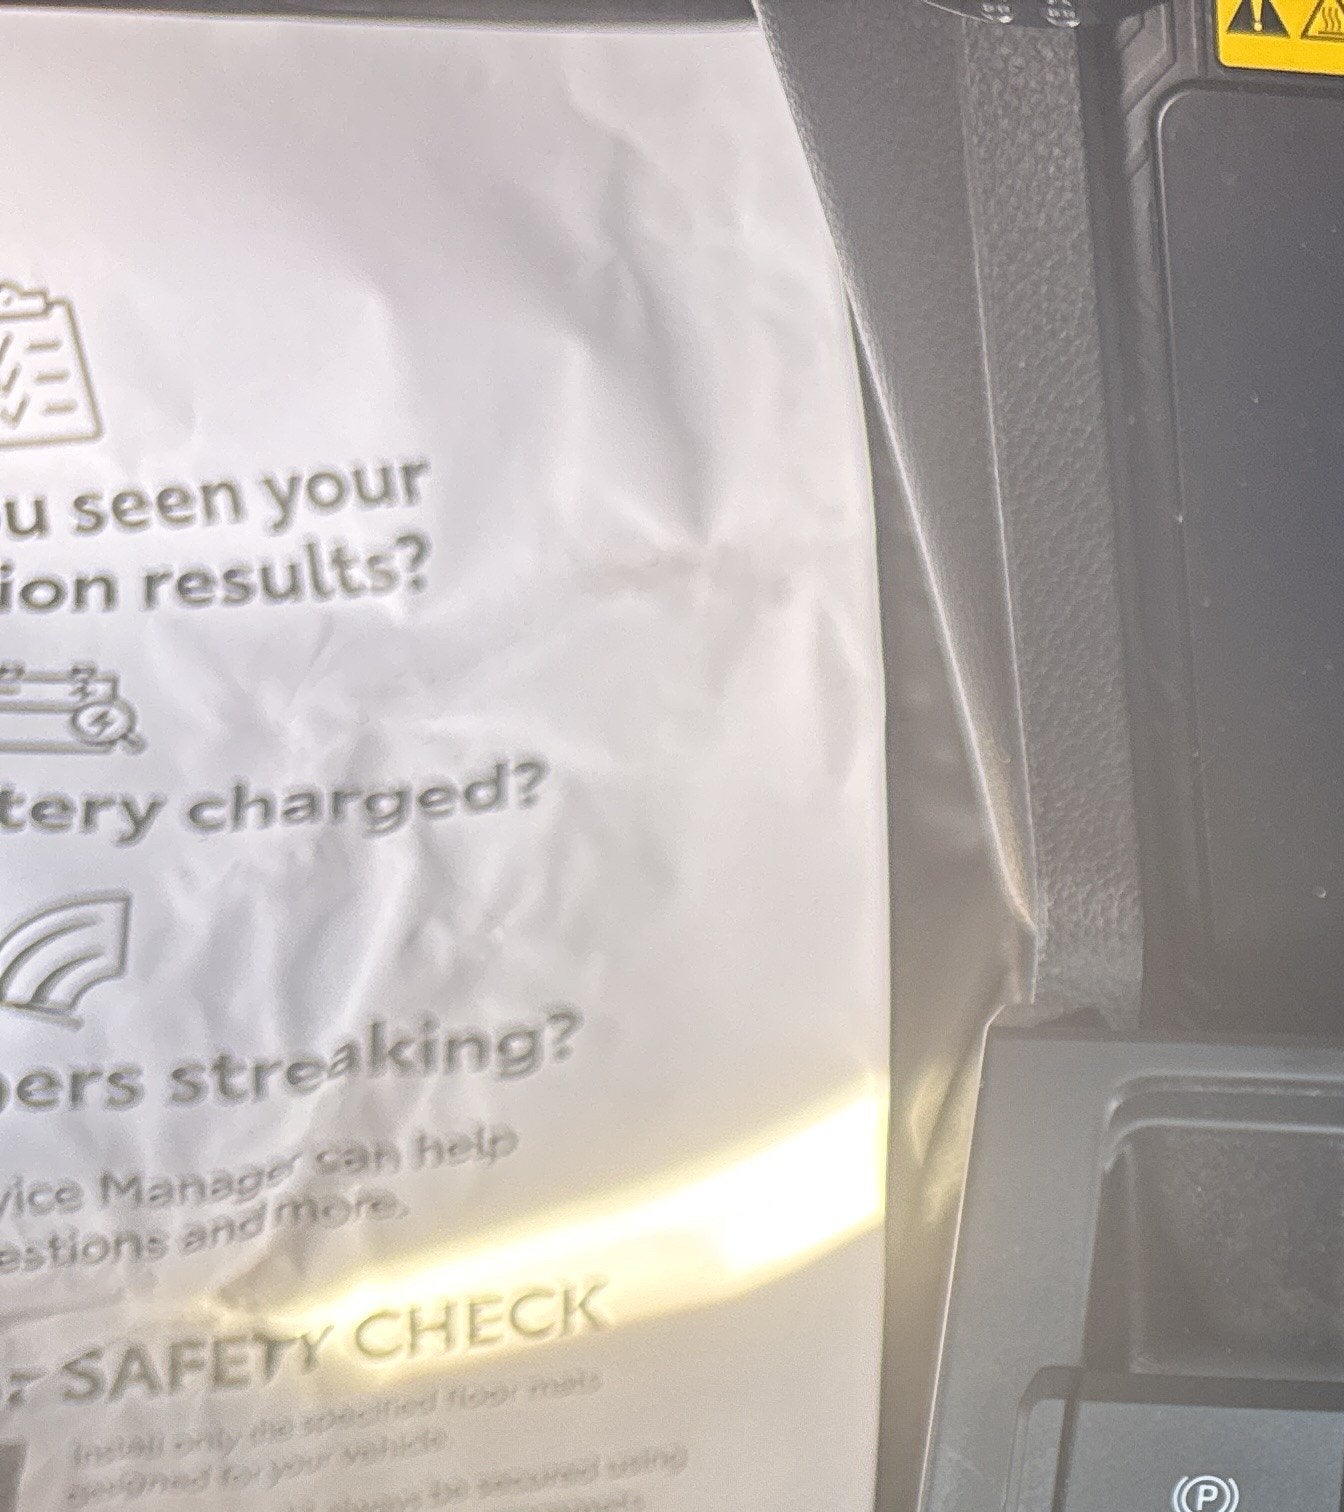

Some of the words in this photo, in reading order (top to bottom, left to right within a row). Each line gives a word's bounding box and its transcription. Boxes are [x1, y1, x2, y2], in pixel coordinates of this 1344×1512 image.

[73, 479, 244, 535] seen
[262, 457, 429, 534] your
[0, 556, 117, 612] ion
[141, 532, 431, 611] results?
[0, 782, 168, 848] tery
[187, 755, 549, 837] charged?
[0, 1062, 145, 1112] ers
[169, 1004, 585, 1104] streaking?
[100, 1152, 300, 1211] Manager
[413, 1120, 520, 1168] help
[0, 1226, 167, 1275] estions
[181, 1204, 265, 1256] and
[62, 1324, 334, 1404] SAFETY
[354, 1279, 608, 1362] CHECK
